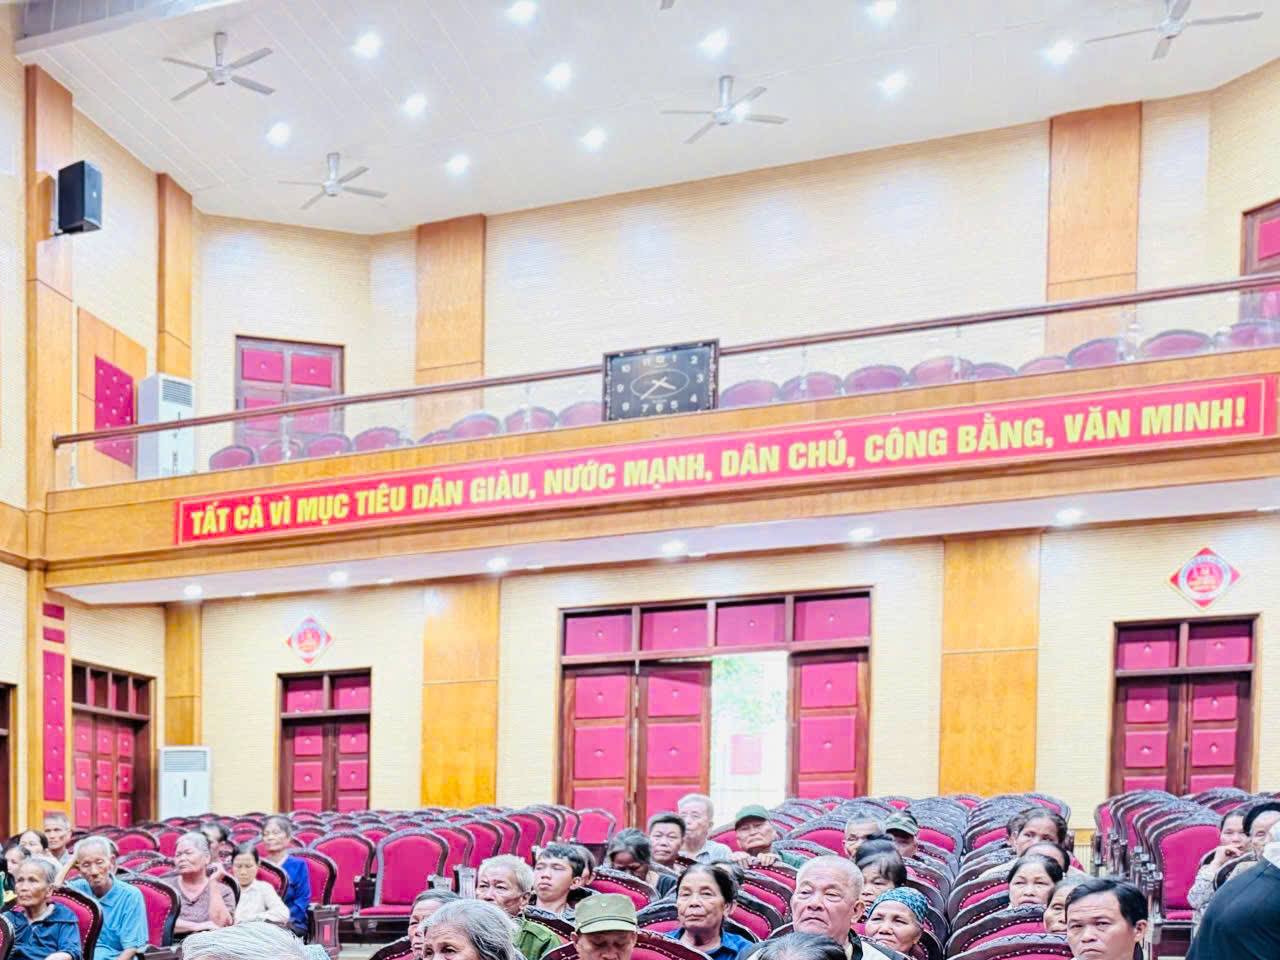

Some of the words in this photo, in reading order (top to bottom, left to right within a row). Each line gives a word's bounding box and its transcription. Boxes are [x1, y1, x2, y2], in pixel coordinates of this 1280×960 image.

[191, 502, 230, 535] TẤT
[234, 496, 265, 531] CẢ
[270, 495, 291, 526] VÌ
[297, 493, 349, 525] MỤC
[355, 483, 406, 516] TIÊU
[412, 477, 464, 509] DÂN
[470, 470, 536, 504] GIÀU,
[543, 459, 615, 496] NƯỚC
[623, 452, 713, 490] MẠNH,
[720, 442, 780, 478] DÂN
[788, 429, 856, 471] CHỦ,
[864, 426, 948, 463] CÔNG
[956, 411, 1054, 454] BẰNG,
[1063, 406, 1131, 443] VĂN
[1140, 396, 1246, 435] MINH!
